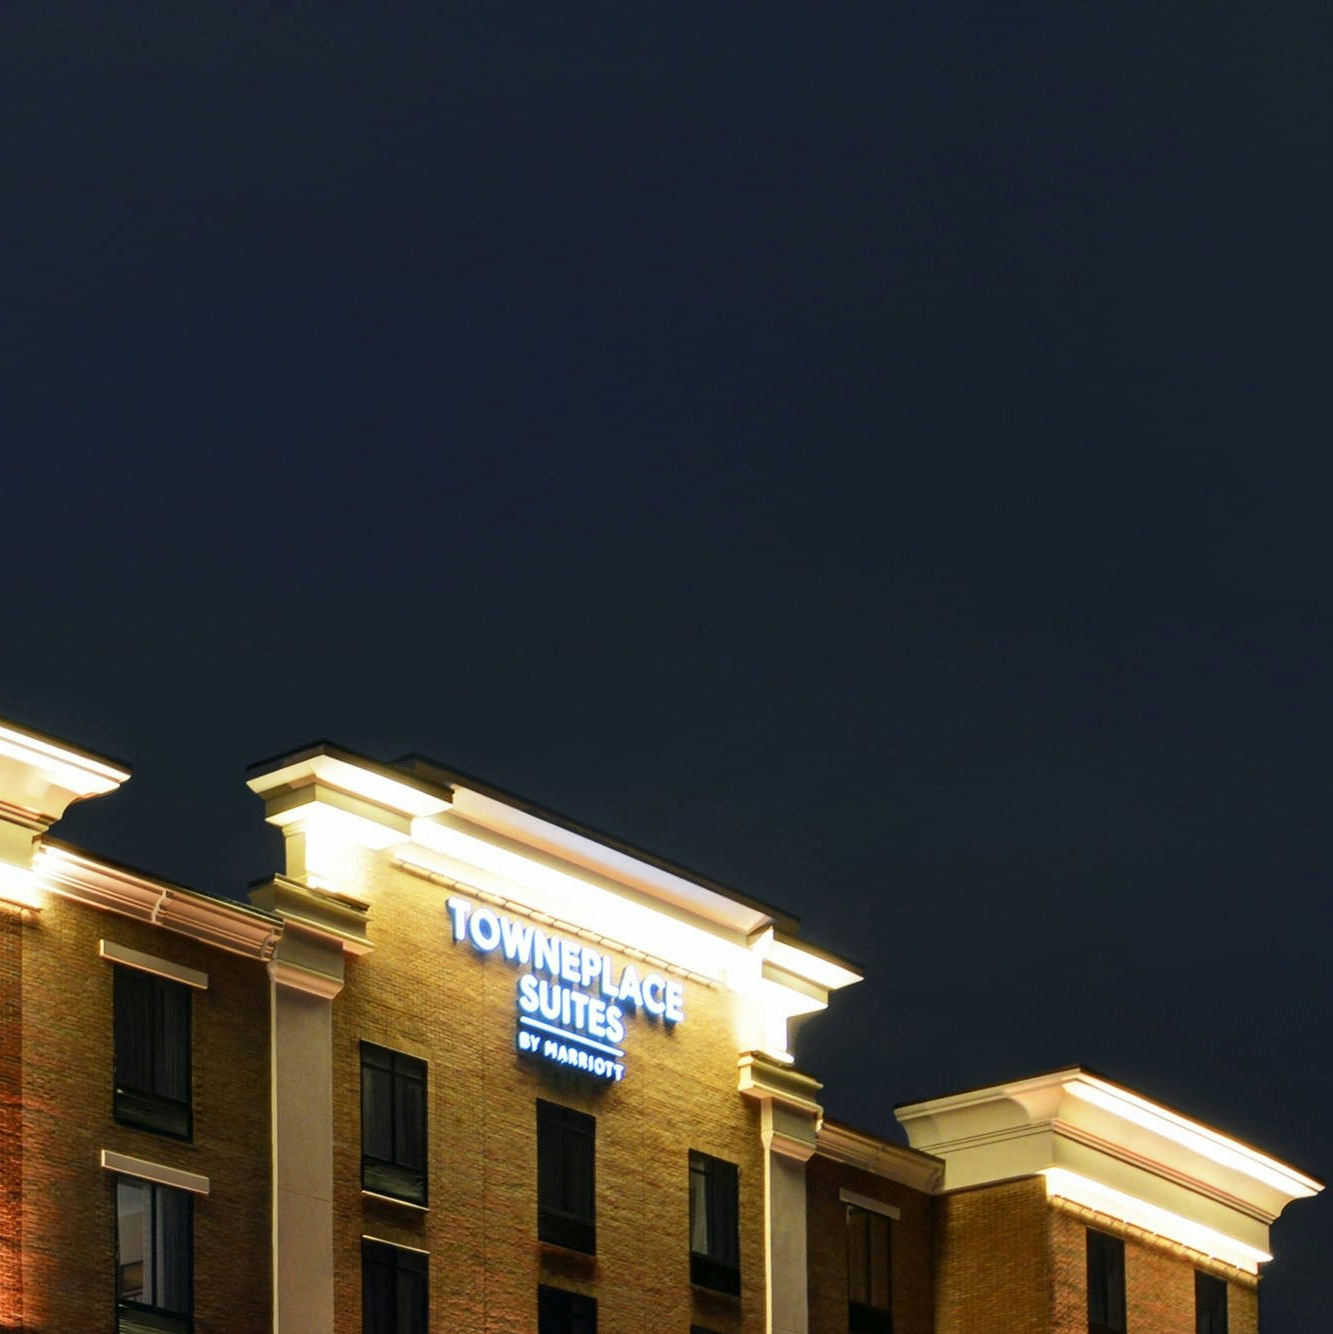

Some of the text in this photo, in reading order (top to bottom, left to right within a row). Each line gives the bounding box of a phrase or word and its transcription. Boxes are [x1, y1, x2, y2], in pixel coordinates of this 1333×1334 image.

[447, 897, 685, 1023] TOWNEPLACE
[518, 973, 625, 1044] SUITES
[519, 1031, 625, 1081] BY MARRIOTT
